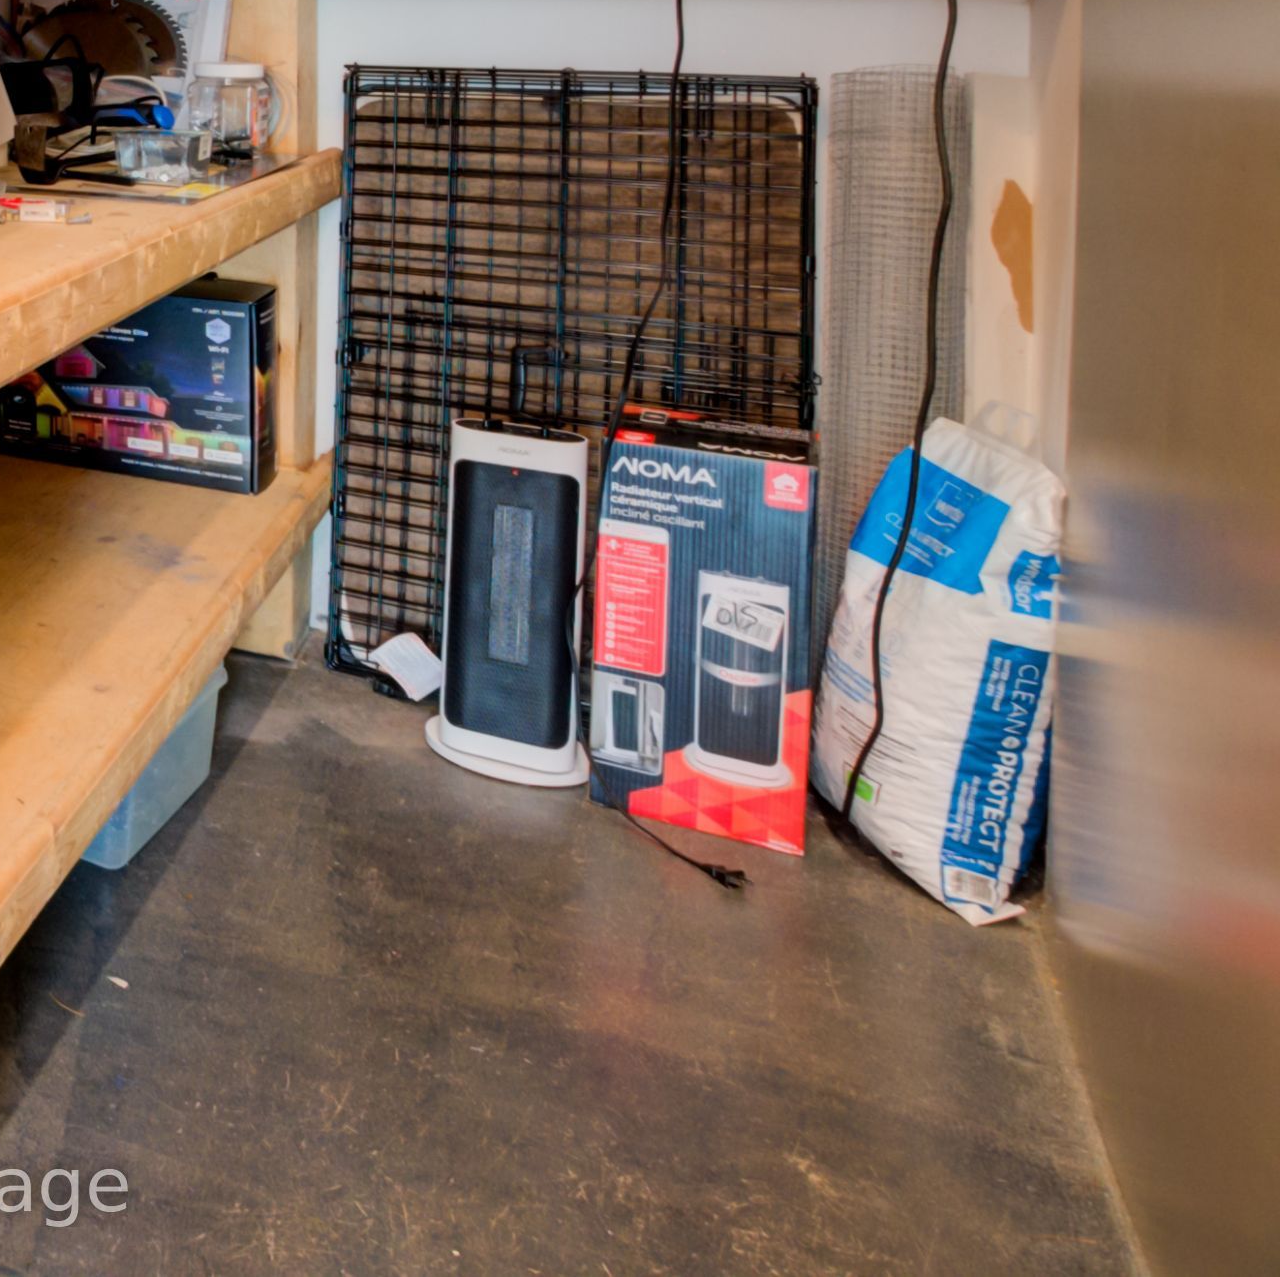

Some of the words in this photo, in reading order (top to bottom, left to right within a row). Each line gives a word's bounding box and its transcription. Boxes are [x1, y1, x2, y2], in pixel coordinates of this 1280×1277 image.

[611, 455, 717, 488] NOMA
[609, 493, 679, 514] céramique
[611, 481, 673, 501] Radiateur
[673, 492, 724, 509] vertical
[609, 506, 651, 521] incliné
[652, 514, 706, 531] oscillant
[1003, 663, 1041, 737] CLEAN
[978, 750, 1019, 854] PROTECT
